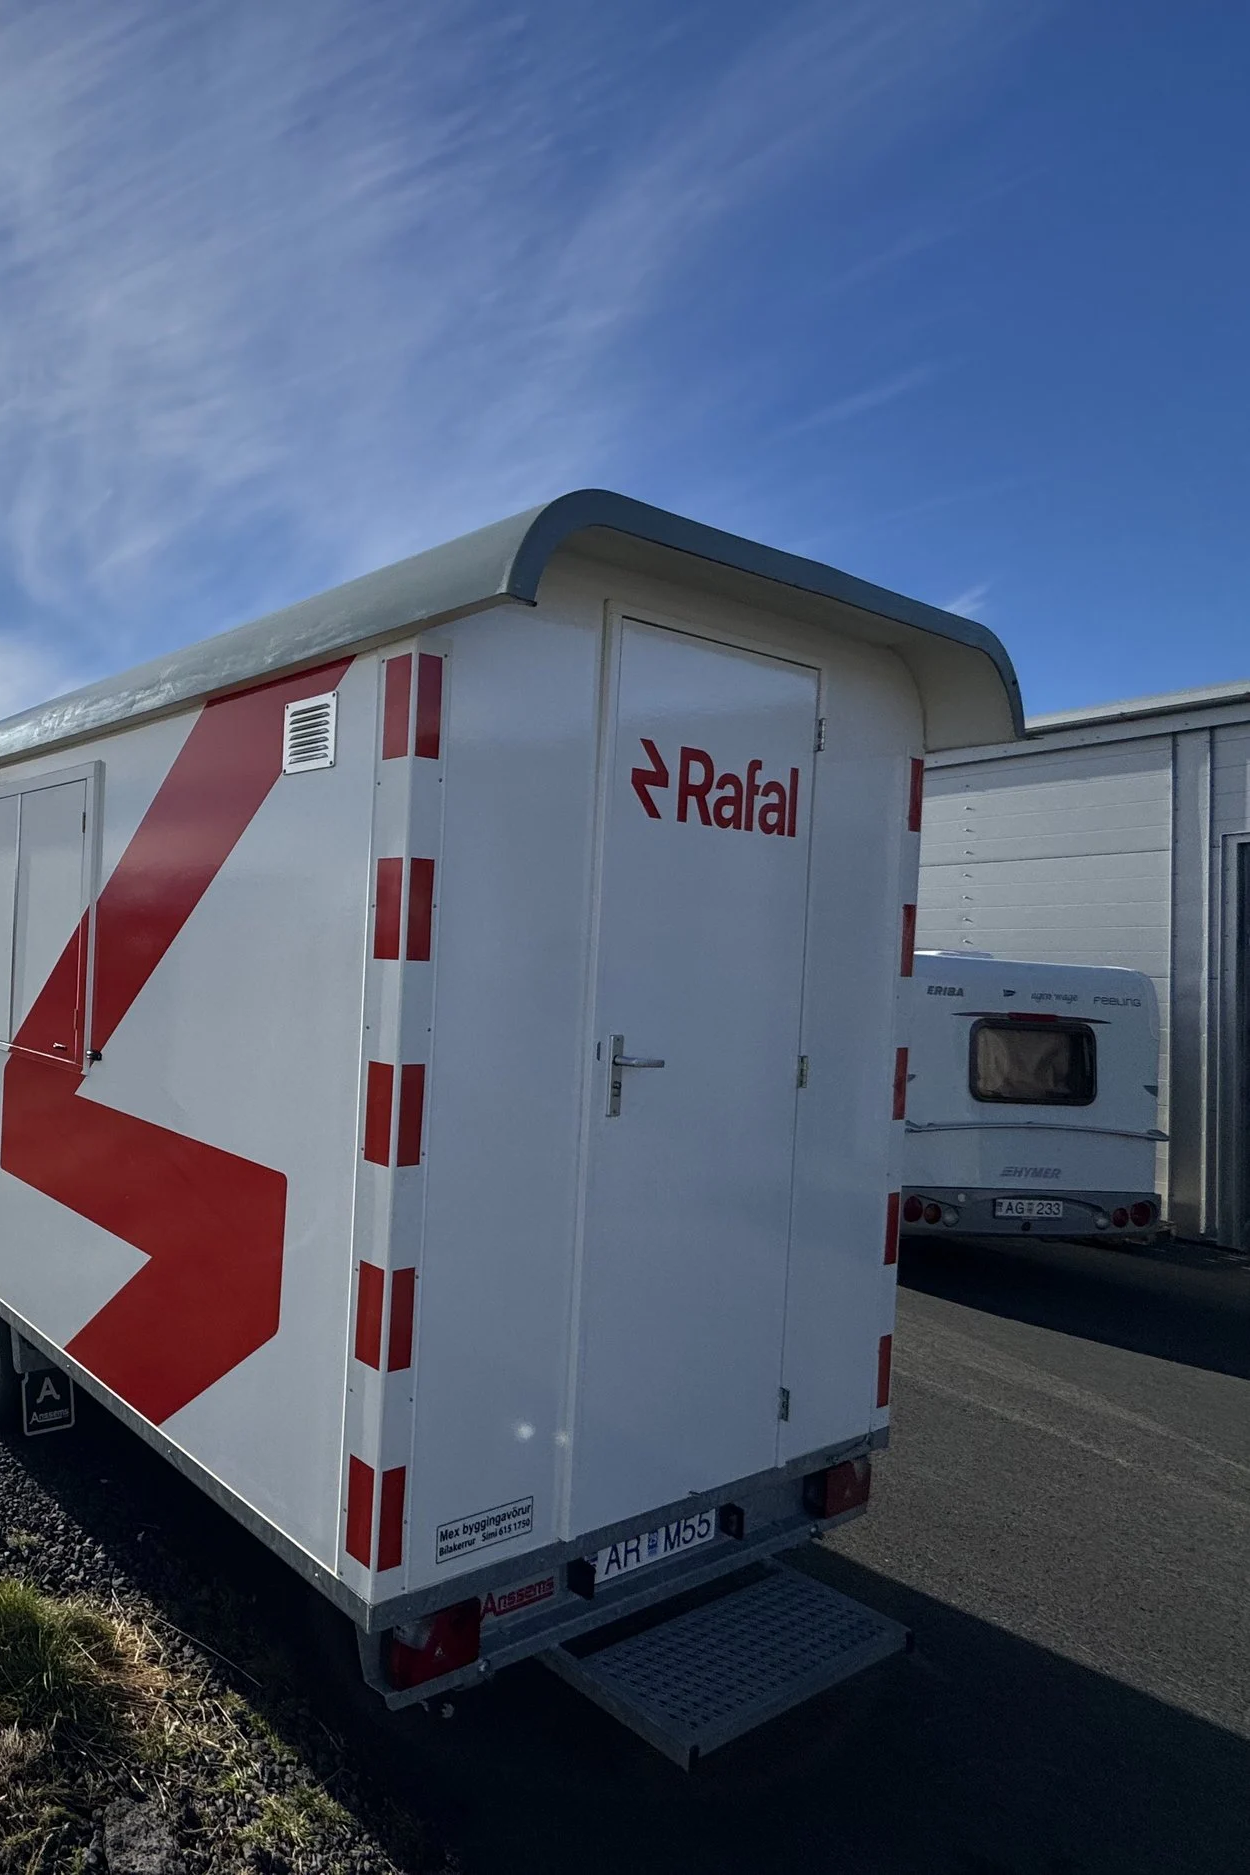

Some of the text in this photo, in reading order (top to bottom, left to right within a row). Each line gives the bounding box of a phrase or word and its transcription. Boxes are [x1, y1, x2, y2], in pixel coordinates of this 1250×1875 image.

[676, 746, 799, 837] Rafal
[927, 986, 963, 997] ERIBA
[1011, 1166, 1061, 1179] HYMER
[1006, 1202, 1061, 1215] AG 233
[36, 1376, 62, 1404] A
[440, 1505, 531, 1542] Mex byggingavörur
[498, 1524, 512, 1536] 615
[513, 1518, 531, 1531] 1750
[605, 1512, 711, 1575] AR M55
